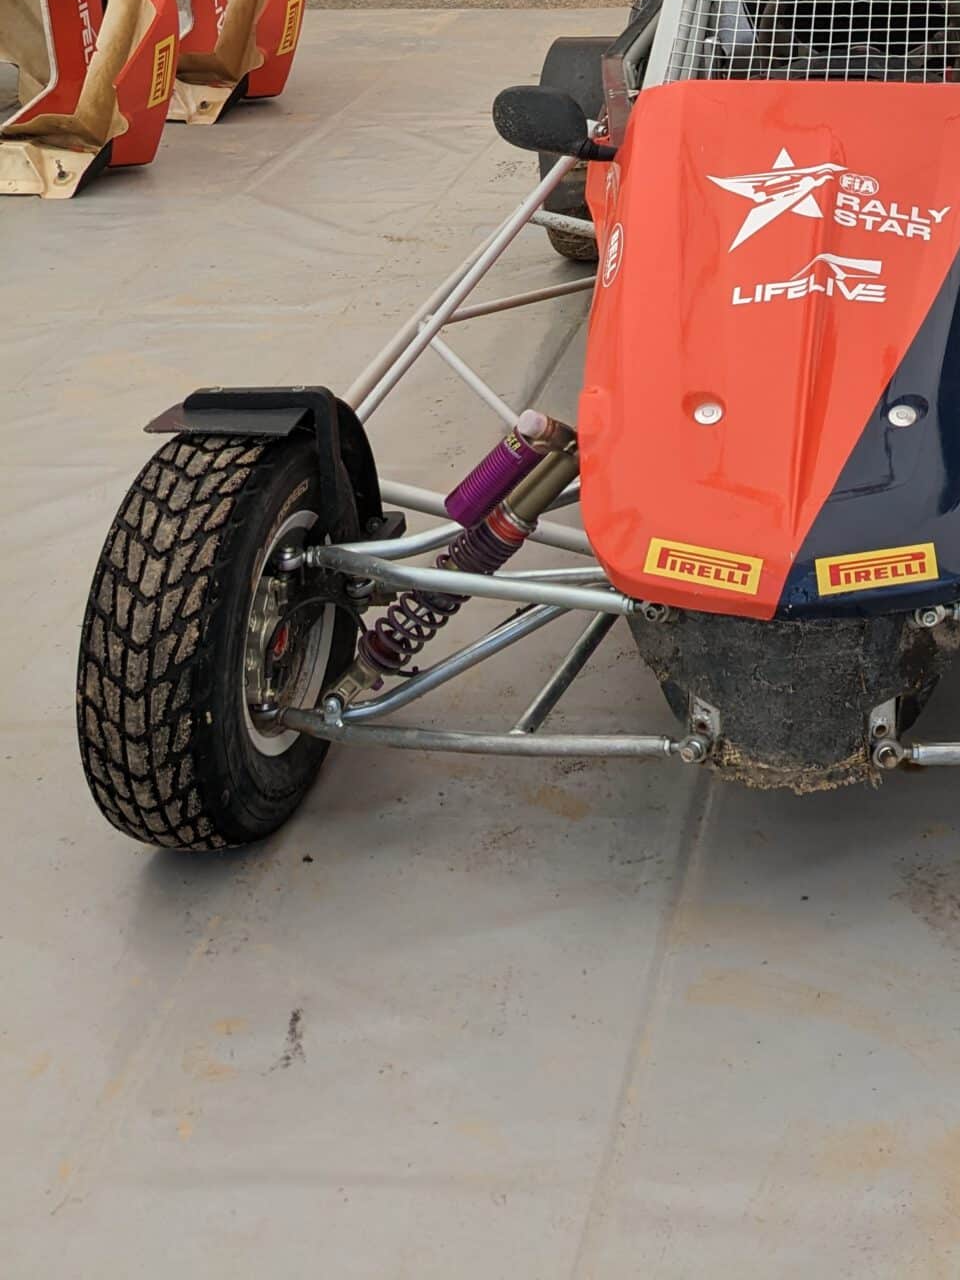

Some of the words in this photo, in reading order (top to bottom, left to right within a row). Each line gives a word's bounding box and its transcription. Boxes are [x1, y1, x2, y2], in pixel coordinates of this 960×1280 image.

[281, 0, 300, 51] PIRELLI
[151, 43, 174, 102] PIRELLI
[842, 176, 876, 193] FIA
[834, 209, 932, 240] STAR
[836, 192, 951, 223] RALLY
[606, 229, 620, 279] BELL
[732, 274, 887, 305] LIFELIVE
[657, 546, 752, 586] PIRELLI
[829, 551, 926, 587] PIRELLI
